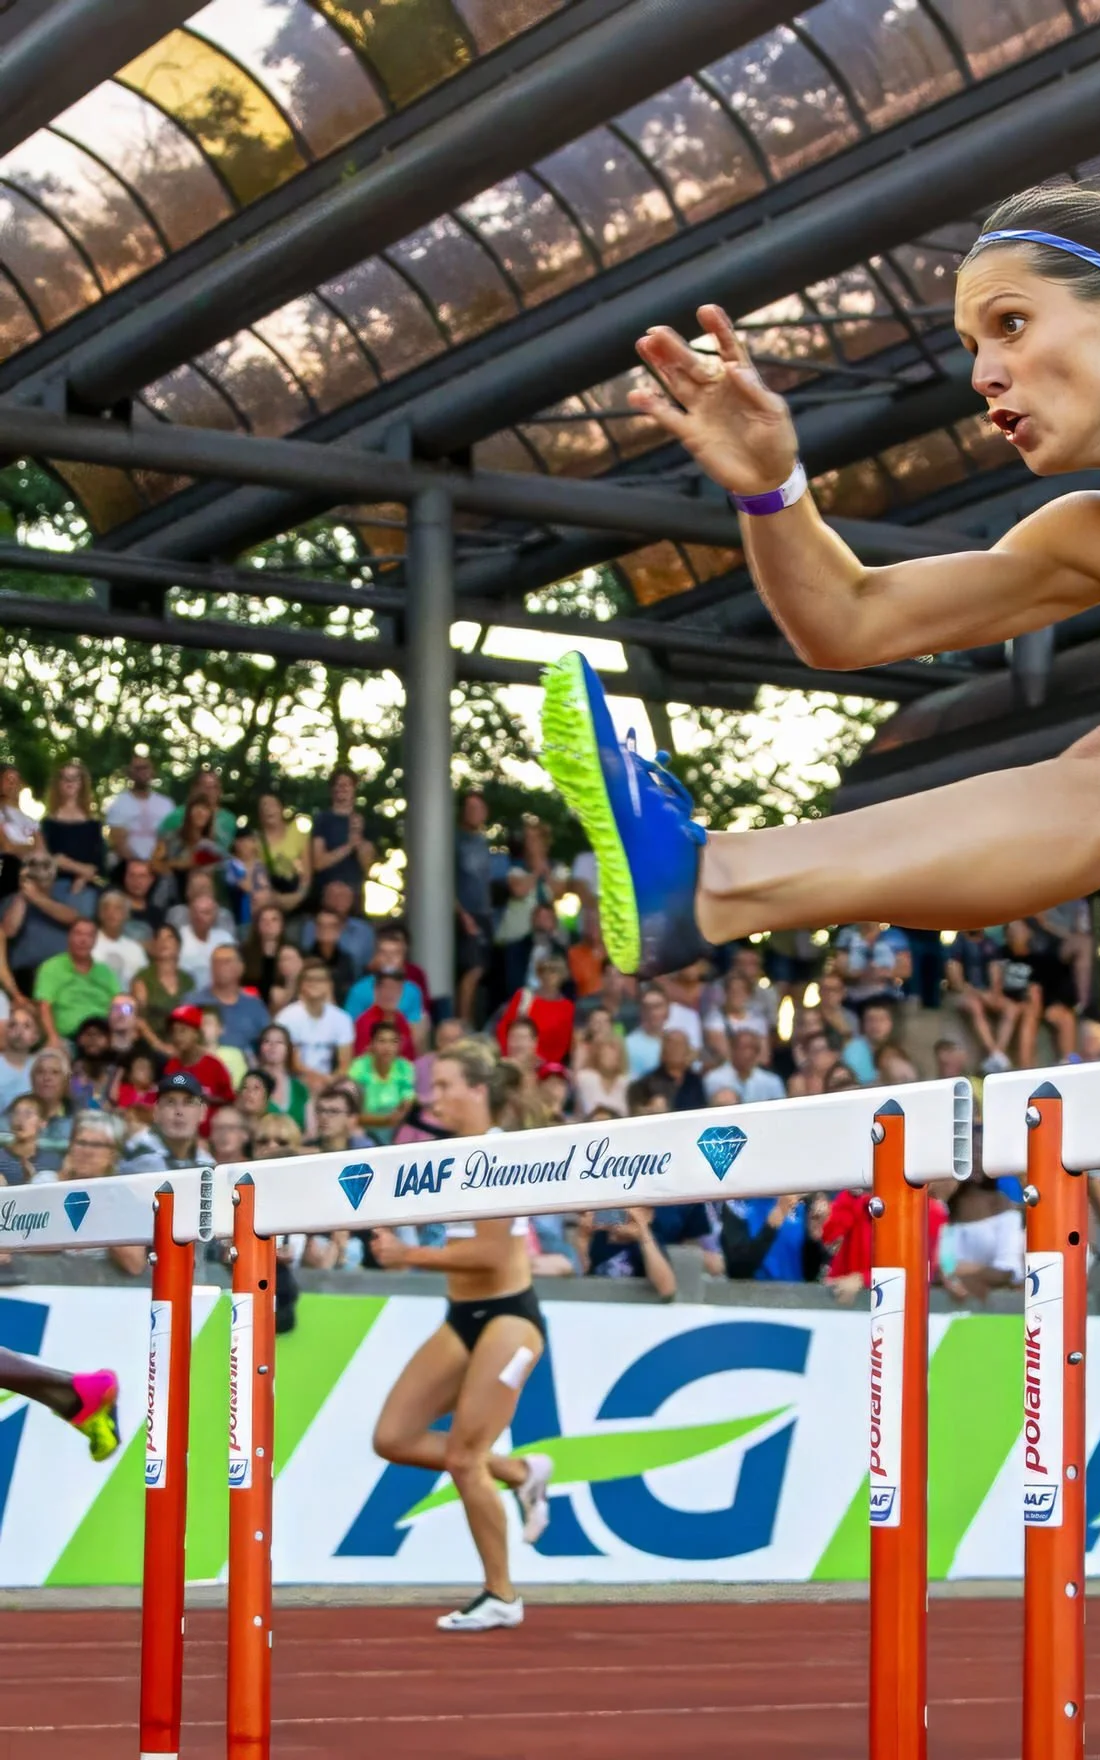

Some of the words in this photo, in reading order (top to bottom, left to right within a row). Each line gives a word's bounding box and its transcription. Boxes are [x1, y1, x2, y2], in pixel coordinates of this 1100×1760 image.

[394, 1157, 455, 1197] IAAF
[461, 1144, 577, 1190] Diamond
[580, 1137, 672, 1190] League
[1024, 1325, 1048, 1475] polanik
